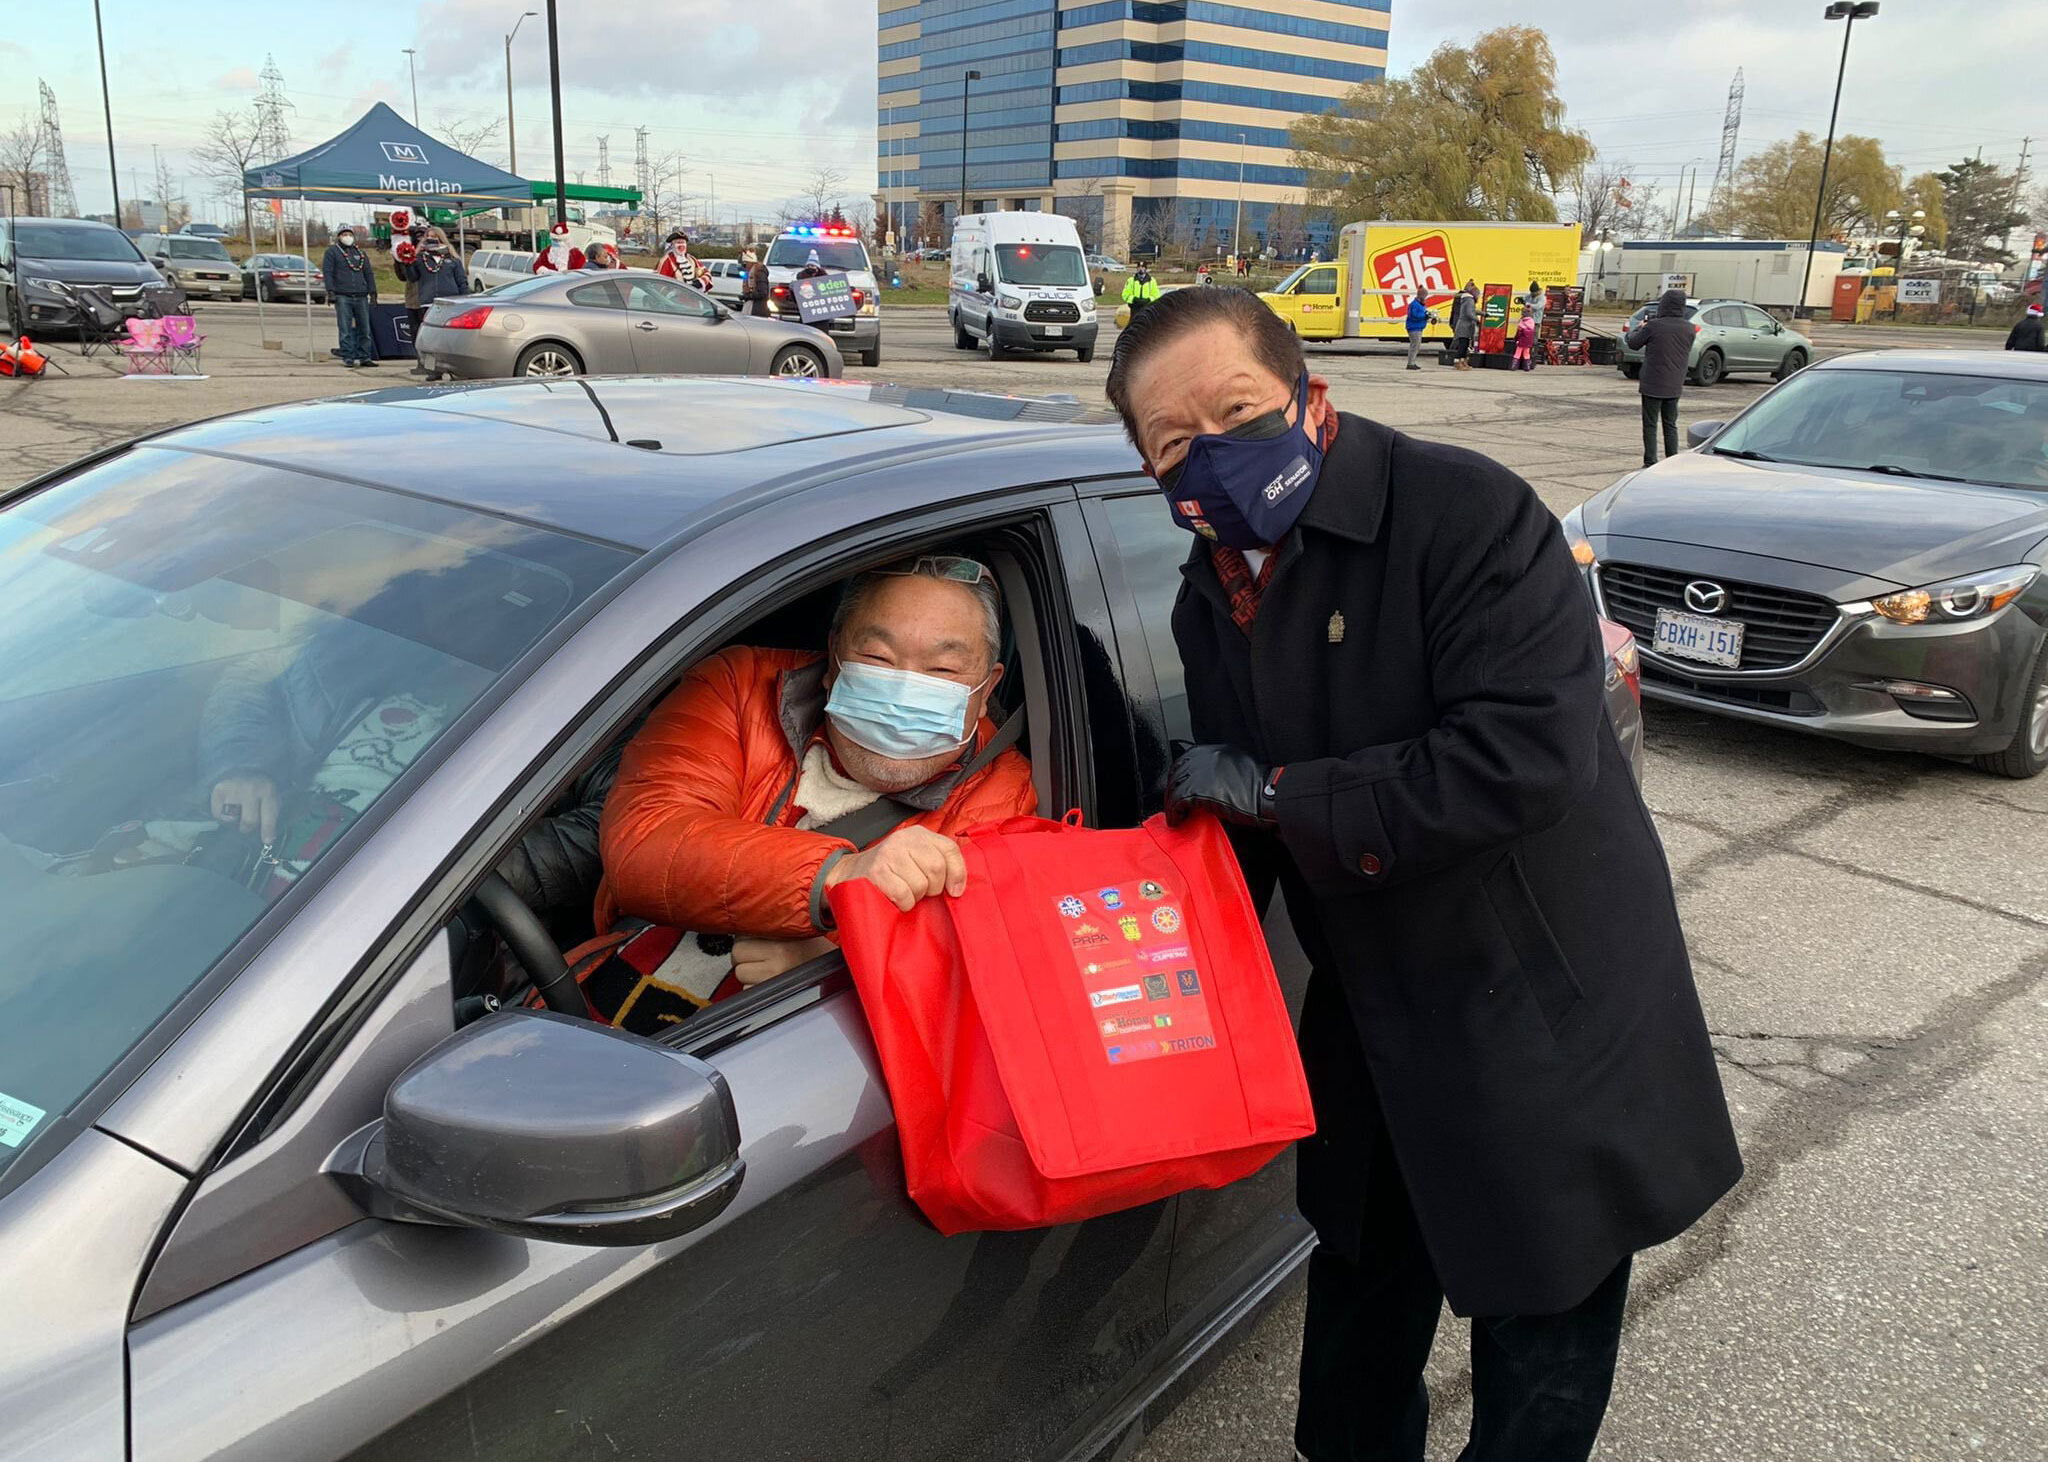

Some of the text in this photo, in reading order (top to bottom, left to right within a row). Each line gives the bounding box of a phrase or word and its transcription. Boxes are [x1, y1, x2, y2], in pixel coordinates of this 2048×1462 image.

[379, 174, 462, 194] Meridian
[802, 295, 850, 308] GOOD FOOD
[1028, 291, 1075, 299] POLICE
[811, 304, 846, 315] FOR ALL
[1264, 474, 1283, 493] VICTOR
[1267, 464, 1308, 500] OH SENATOR
[1659, 621, 1735, 656] CBXH 151
[1072, 934, 1110, 947] PRPA
[1116, 1016, 1149, 1028] Home
[1168, 1036, 1214, 1052] TRITON
